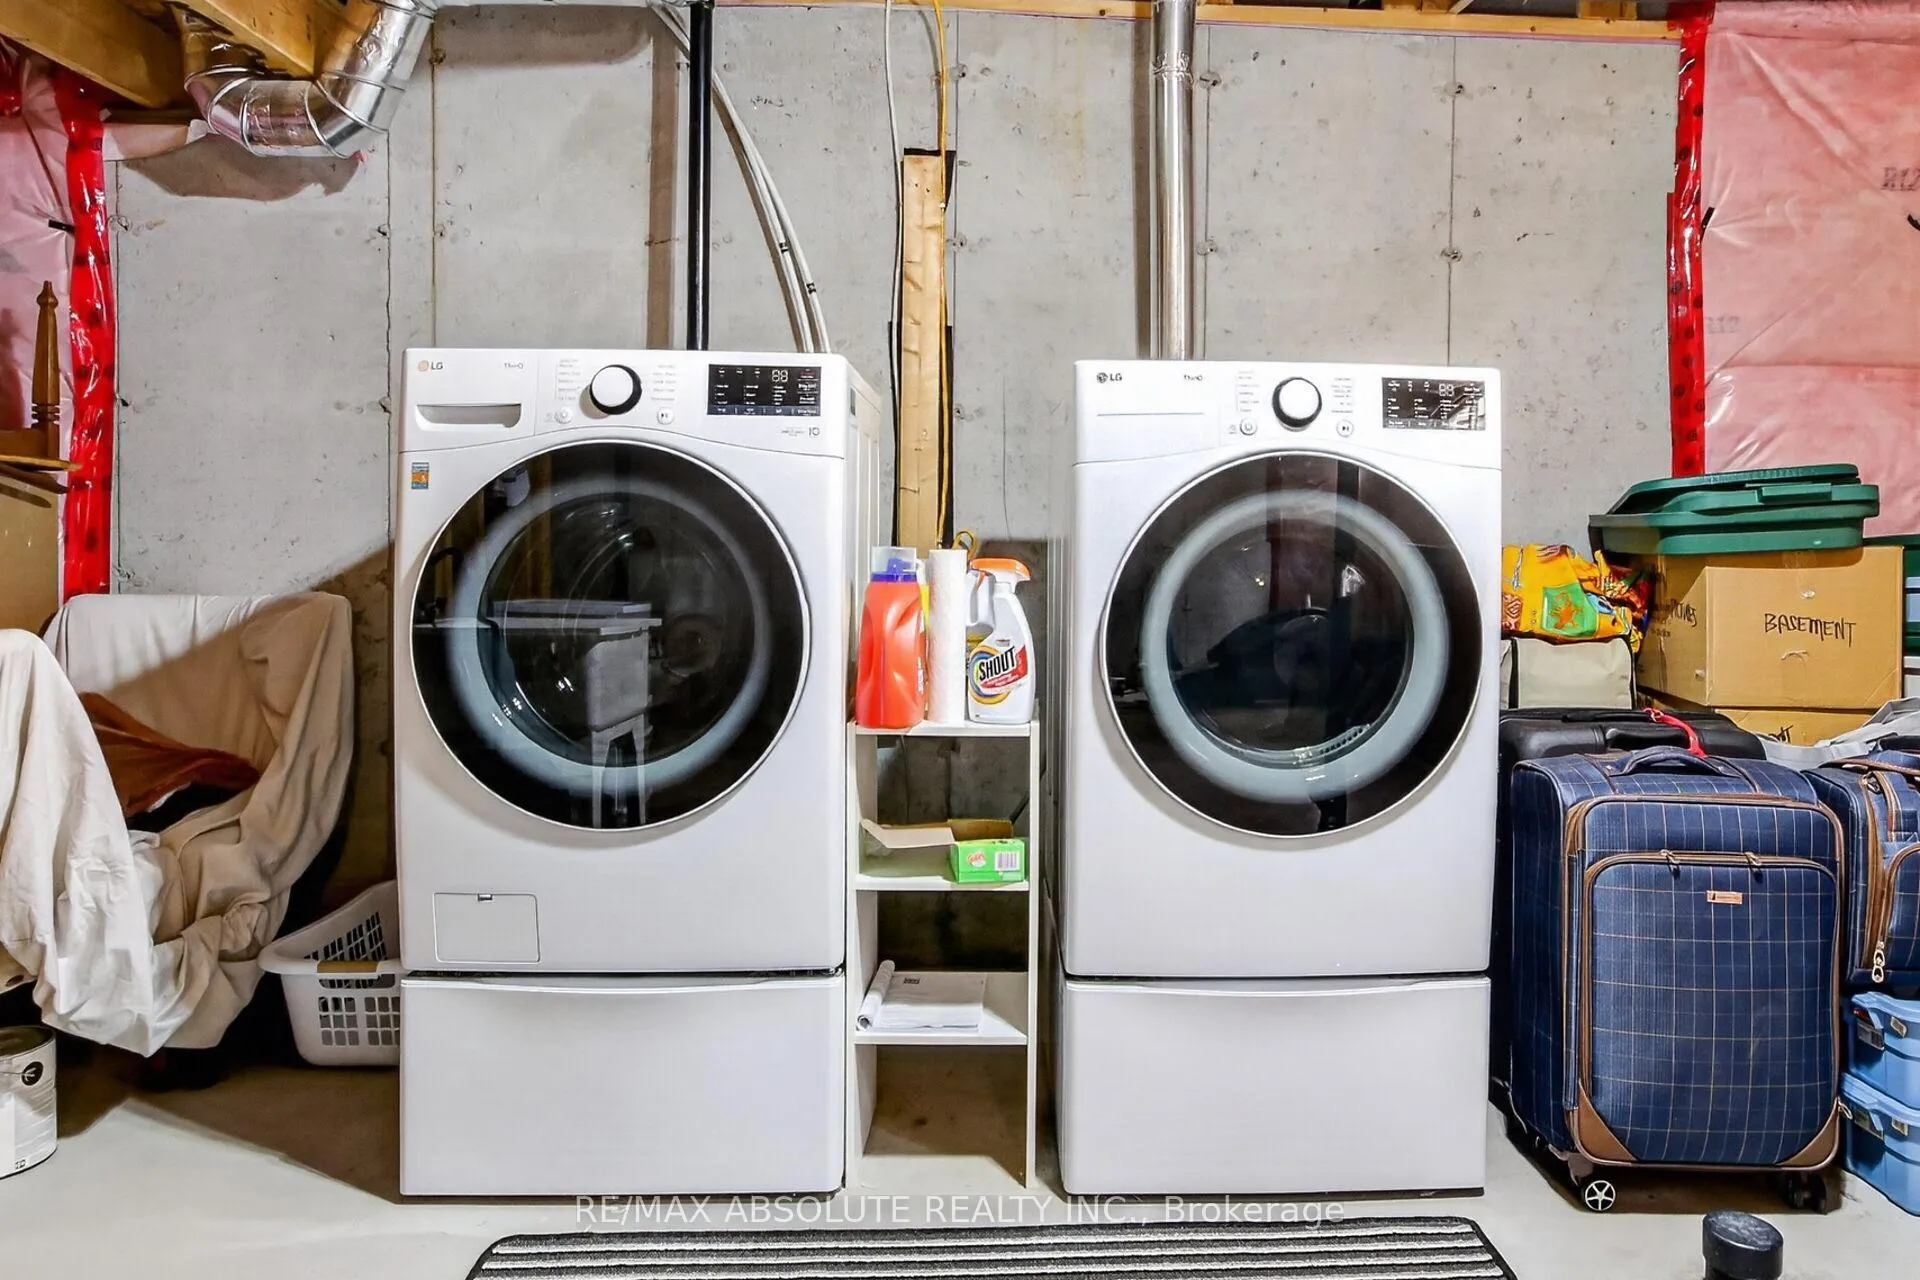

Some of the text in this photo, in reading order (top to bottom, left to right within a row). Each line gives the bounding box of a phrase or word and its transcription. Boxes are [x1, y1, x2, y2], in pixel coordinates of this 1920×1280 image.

[431, 362, 443, 370] LG
[1109, 373, 1122, 381] LG
[1764, 612, 1857, 648] BASEMENT
[979, 645, 1015, 681] SHOUT
